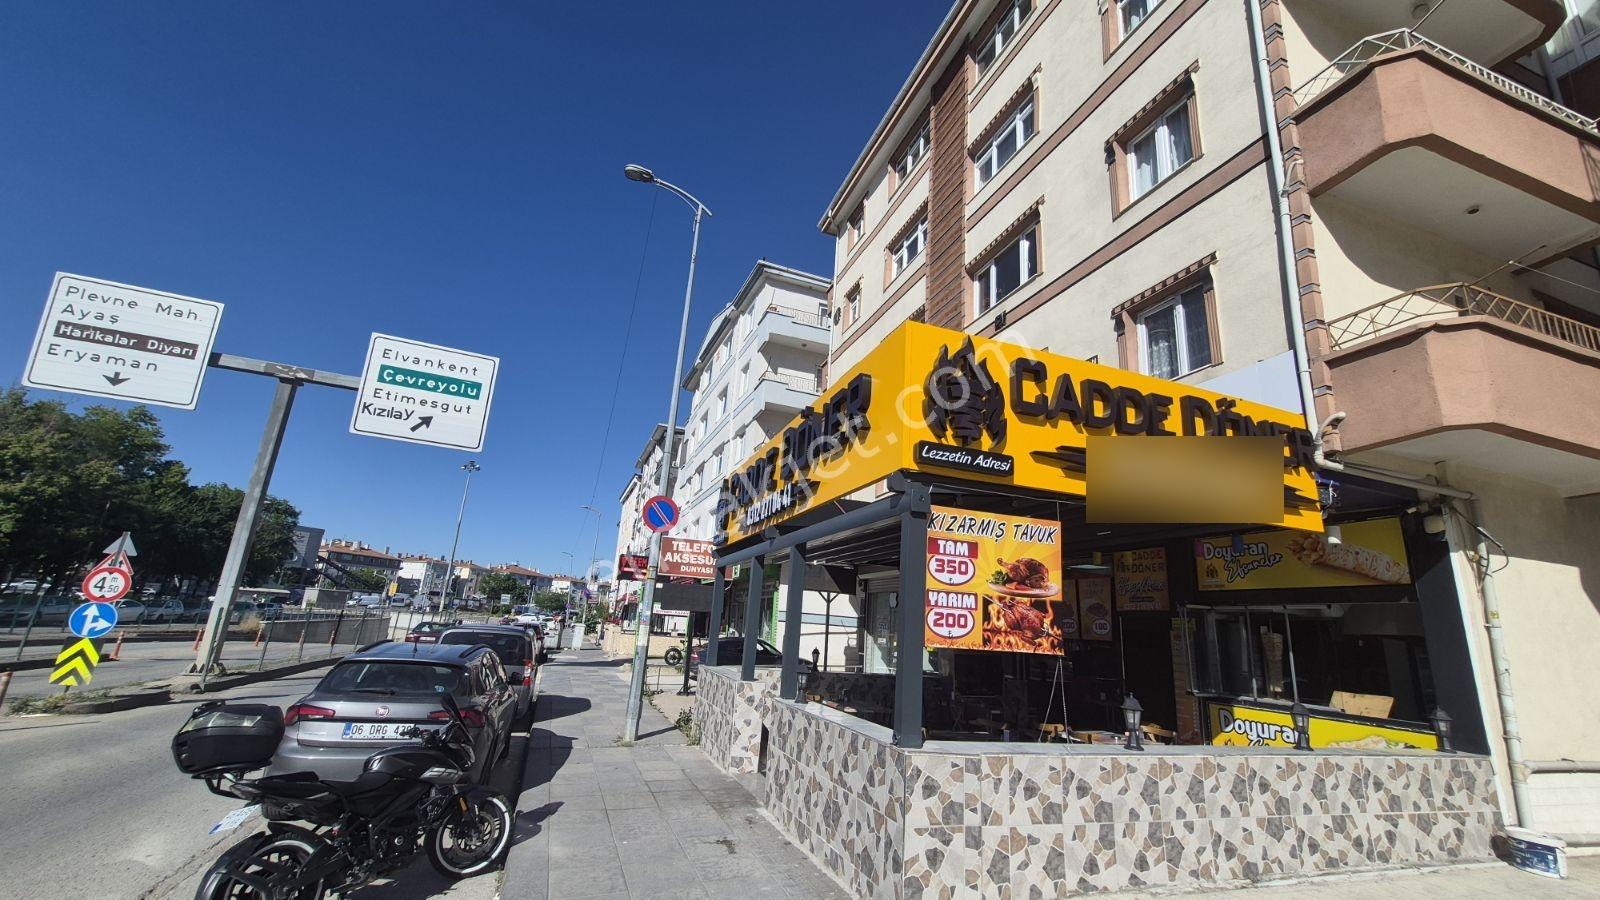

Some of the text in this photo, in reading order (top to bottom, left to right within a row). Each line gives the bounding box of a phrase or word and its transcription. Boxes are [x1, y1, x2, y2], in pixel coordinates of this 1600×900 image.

[61, 303, 120, 324] Ayaş
[65, 285, 203, 322] Plevne Mah.
[59, 324, 194, 356] Harikalar Diyarı
[47, 343, 158, 372] Eryaman
[382, 348, 478, 376] Elvankent
[383, 369, 477, 396] Çevreyolu
[373, 388, 472, 414] Etimesgut
[1010, 357, 1177, 437] CADDE
[361, 402, 415, 421] Kızılay
[921, 445, 1012, 471] Lezzetin Adresi
[928, 512, 1058, 544] KIZARMIŞ TAVUK
[671, 541, 717, 553] TELEFO
[937, 540, 969, 556] TAM
[664, 552, 717, 566] AKSESU
[935, 558, 969, 576] 350
[928, 591, 976, 609] YARIM
[933, 611, 968, 629] 200
[351, 725, 364, 735] 06
[369, 725, 388, 735] DRG
